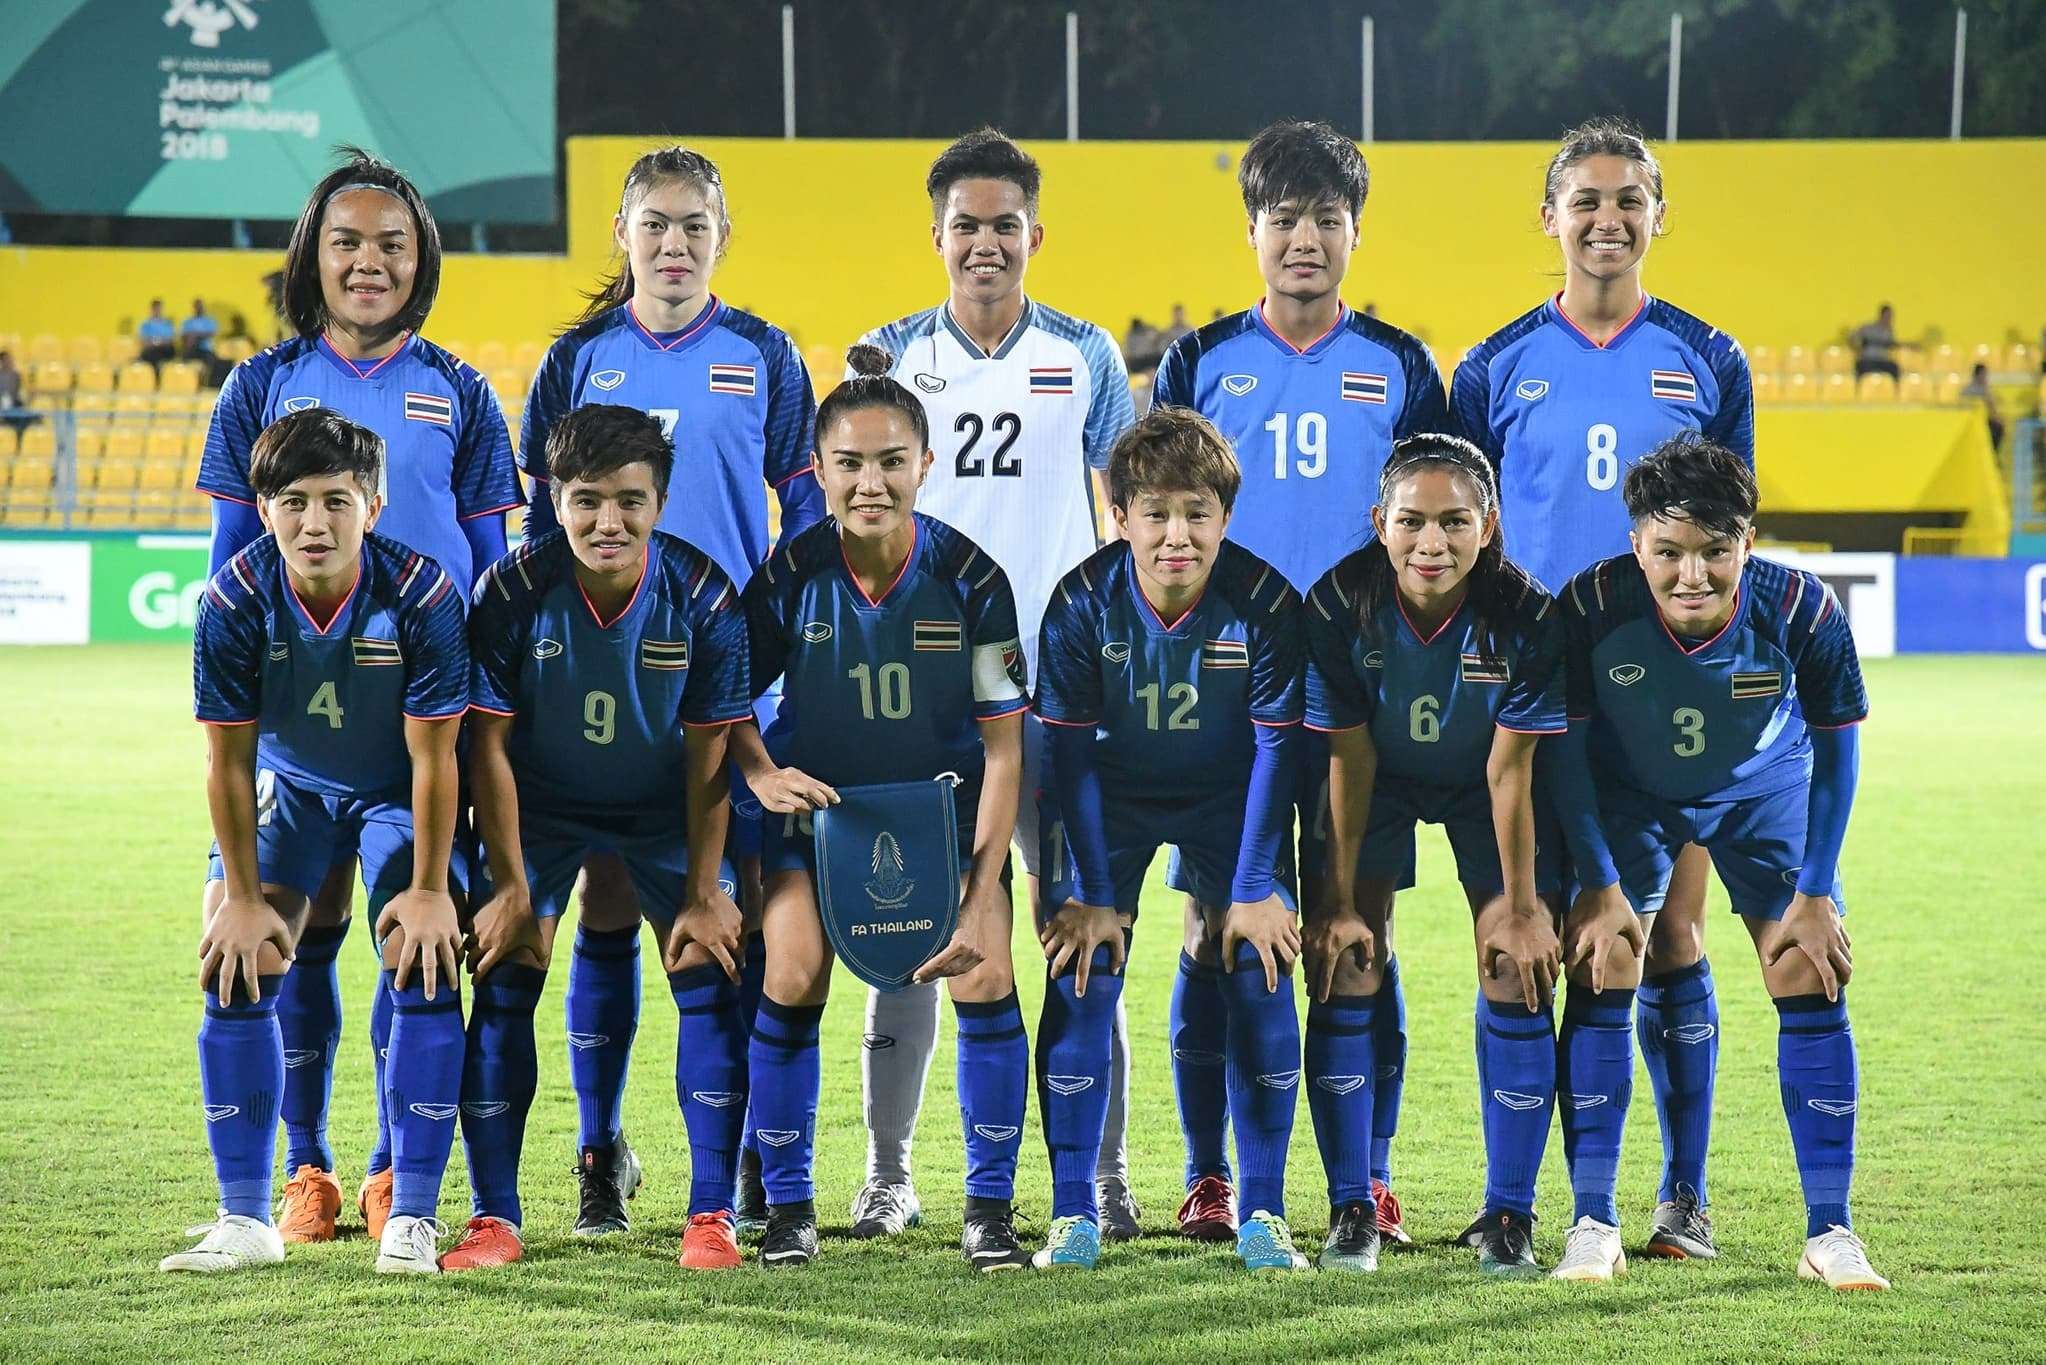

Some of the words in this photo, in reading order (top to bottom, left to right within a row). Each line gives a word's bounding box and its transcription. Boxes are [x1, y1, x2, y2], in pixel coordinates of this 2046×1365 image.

[159, 74, 272, 103] Jakarta
[159, 101, 320, 139] Palembang
[160, 131, 228, 160] 2018
[954, 411, 1022, 478] 22
[1264, 412, 1328, 480] 19
[1585, 423, 1619, 492] 8
[306, 681, 344, 730] 4
[848, 662, 912, 721] 10
[1135, 682, 1200, 731] 12
[583, 690, 616, 745] 9
[1408, 694, 1441, 743] 6
[1672, 706, 1706, 758] 3
[851, 923, 868, 937] FA
[869, 918, 934, 935] THAILAND
